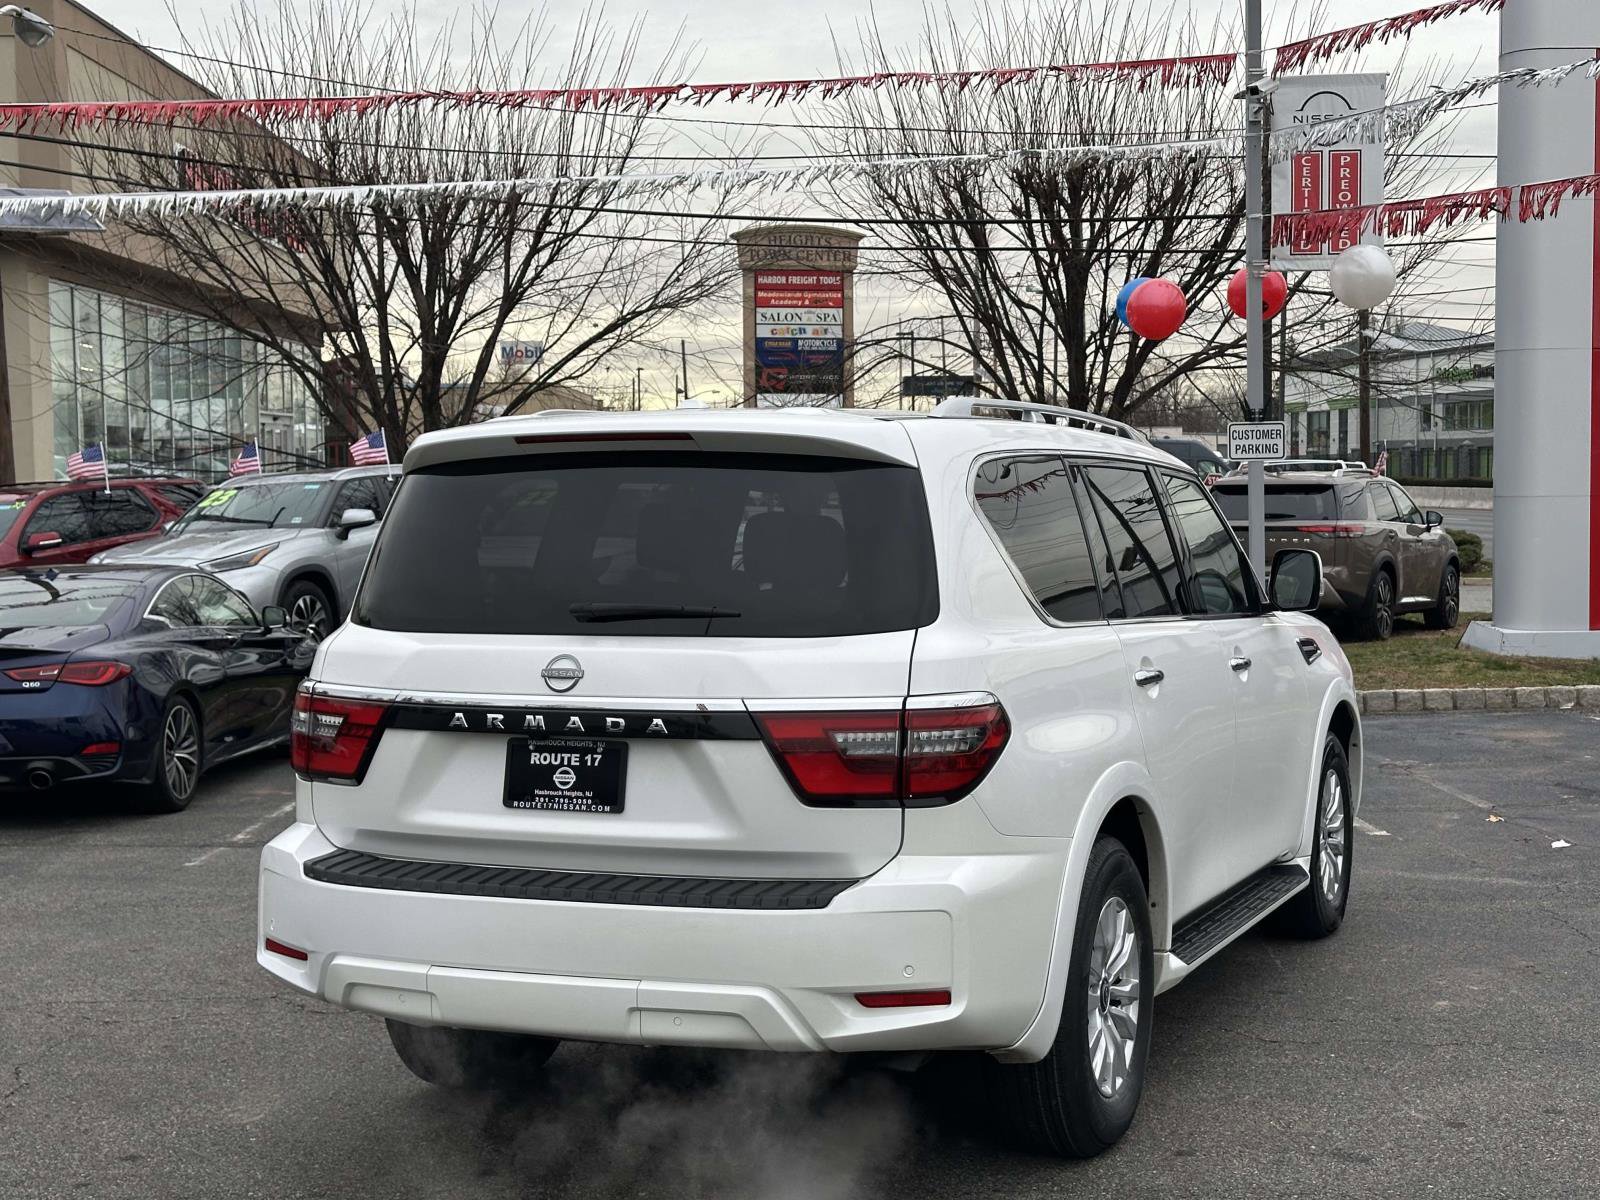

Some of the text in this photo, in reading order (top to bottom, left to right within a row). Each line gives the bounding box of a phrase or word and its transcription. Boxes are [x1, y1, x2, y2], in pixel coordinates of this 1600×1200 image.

[1293, 114, 1344, 124] NISS
[1300, 156, 1312, 250] CERTID
[1336, 155, 1354, 249] PREOWED
[767, 235, 832, 247] HEIGHTS
[797, 249, 852, 262] CENTER
[758, 275, 841, 285] HARBOR FREIGHT TOOLS
[760, 312, 802, 322] SALON
[816, 312, 838, 322] SPA
[770, 326, 829, 336] catch air
[798, 339, 838, 347] MOTORCYCLE
[501, 346, 545, 359] Mobil
[1231, 429, 1282, 441] CUSTOMER
[1235, 443, 1279, 455] PARKING
[541, 670, 583, 678] NISSAN
[449, 712, 668, 734] ARMADA
[530, 752, 602, 766] ROUTE 17
[513, 801, 610, 812] ROUTE17NISSAN.COM
